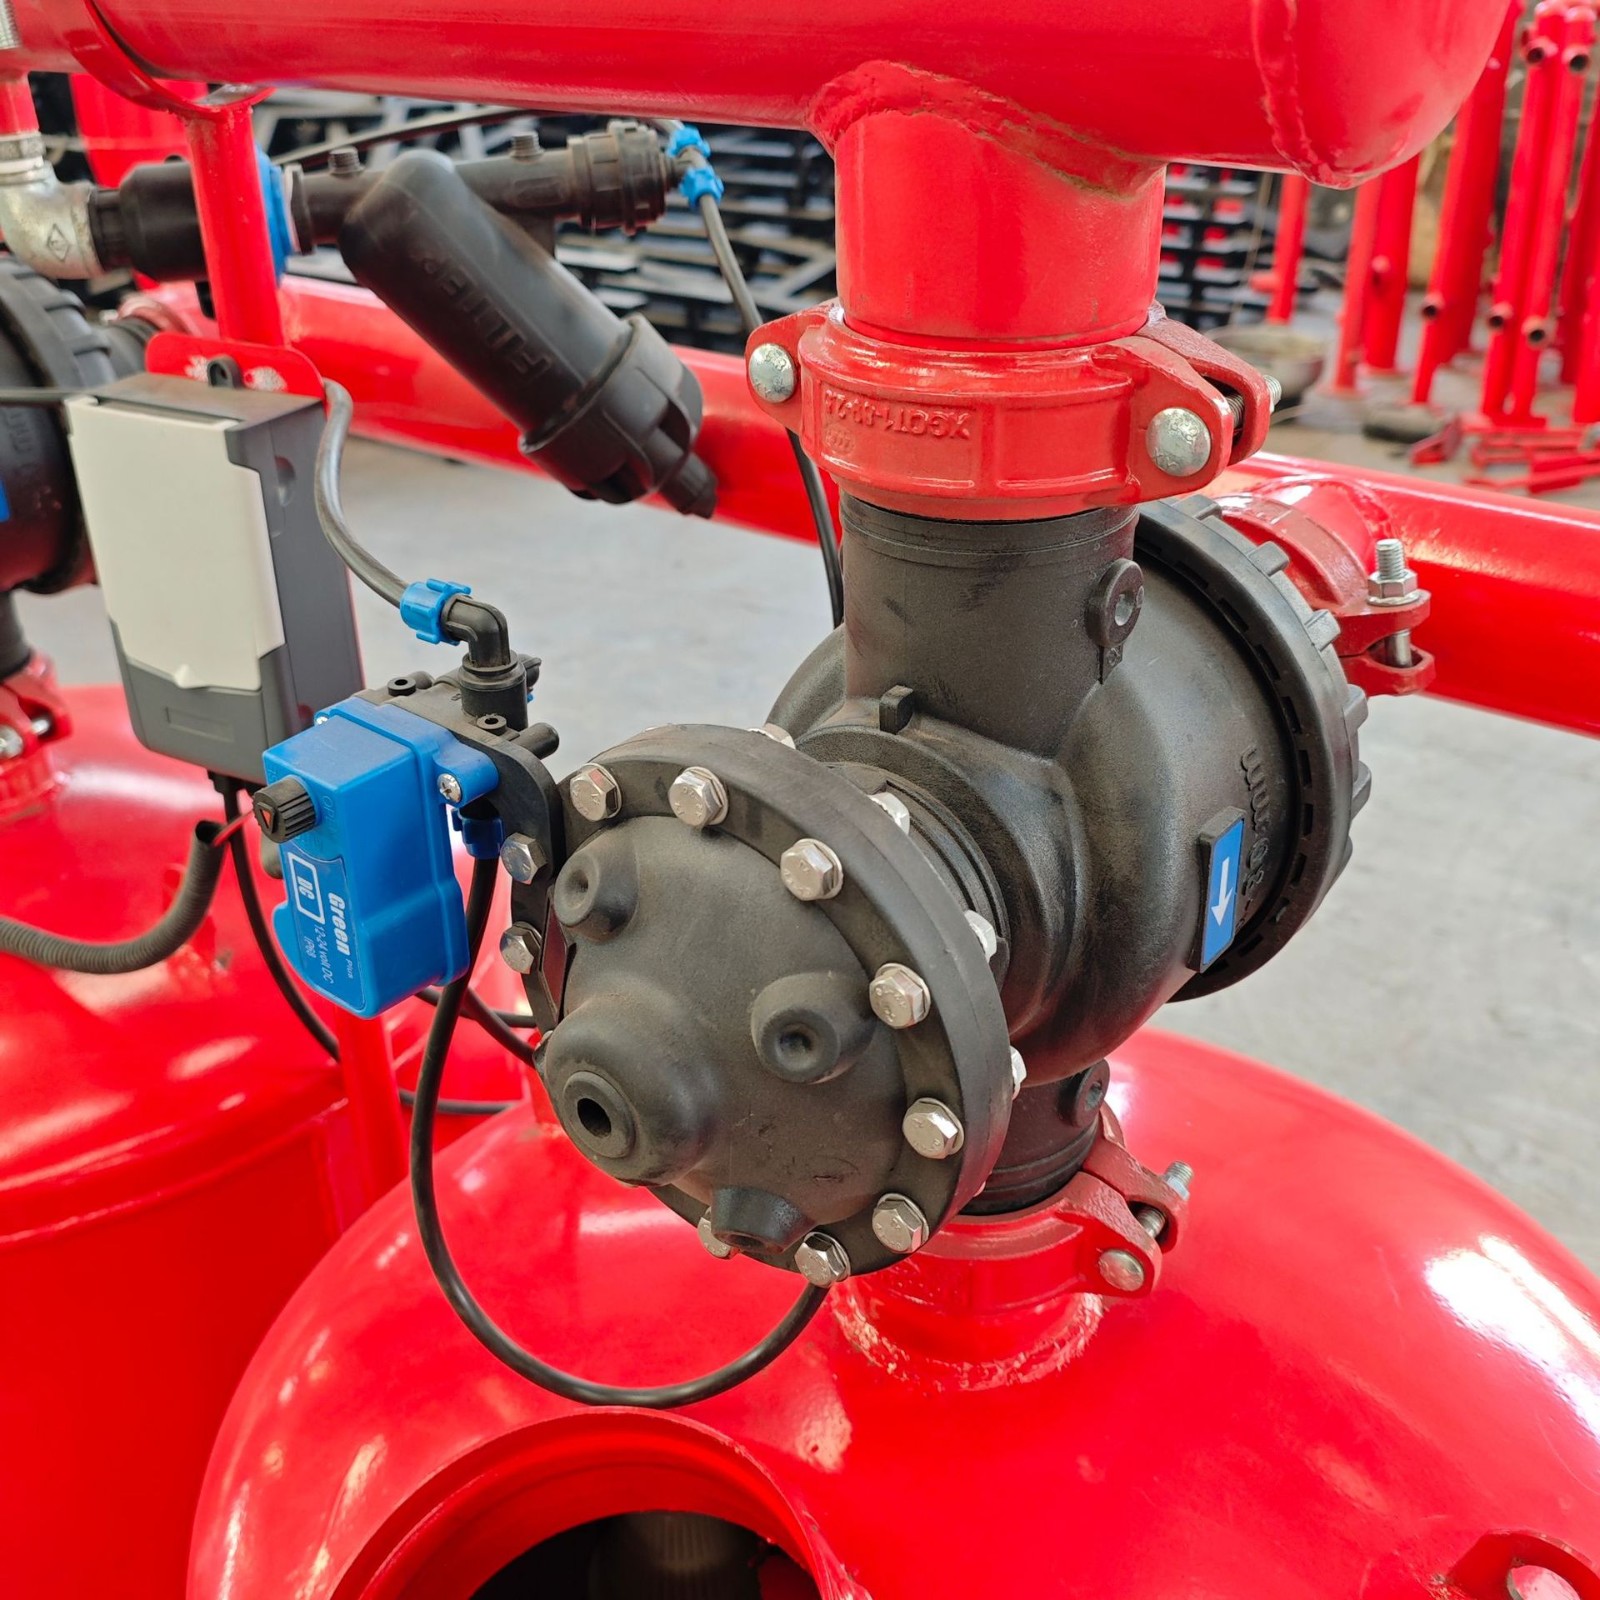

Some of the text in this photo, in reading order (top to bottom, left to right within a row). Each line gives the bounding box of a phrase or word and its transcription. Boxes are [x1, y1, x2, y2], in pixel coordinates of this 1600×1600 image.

[297, 876, 315, 900] DC
[315, 924, 334, 984] 12-24 volt DC
[328, 892, 350, 956] Green
